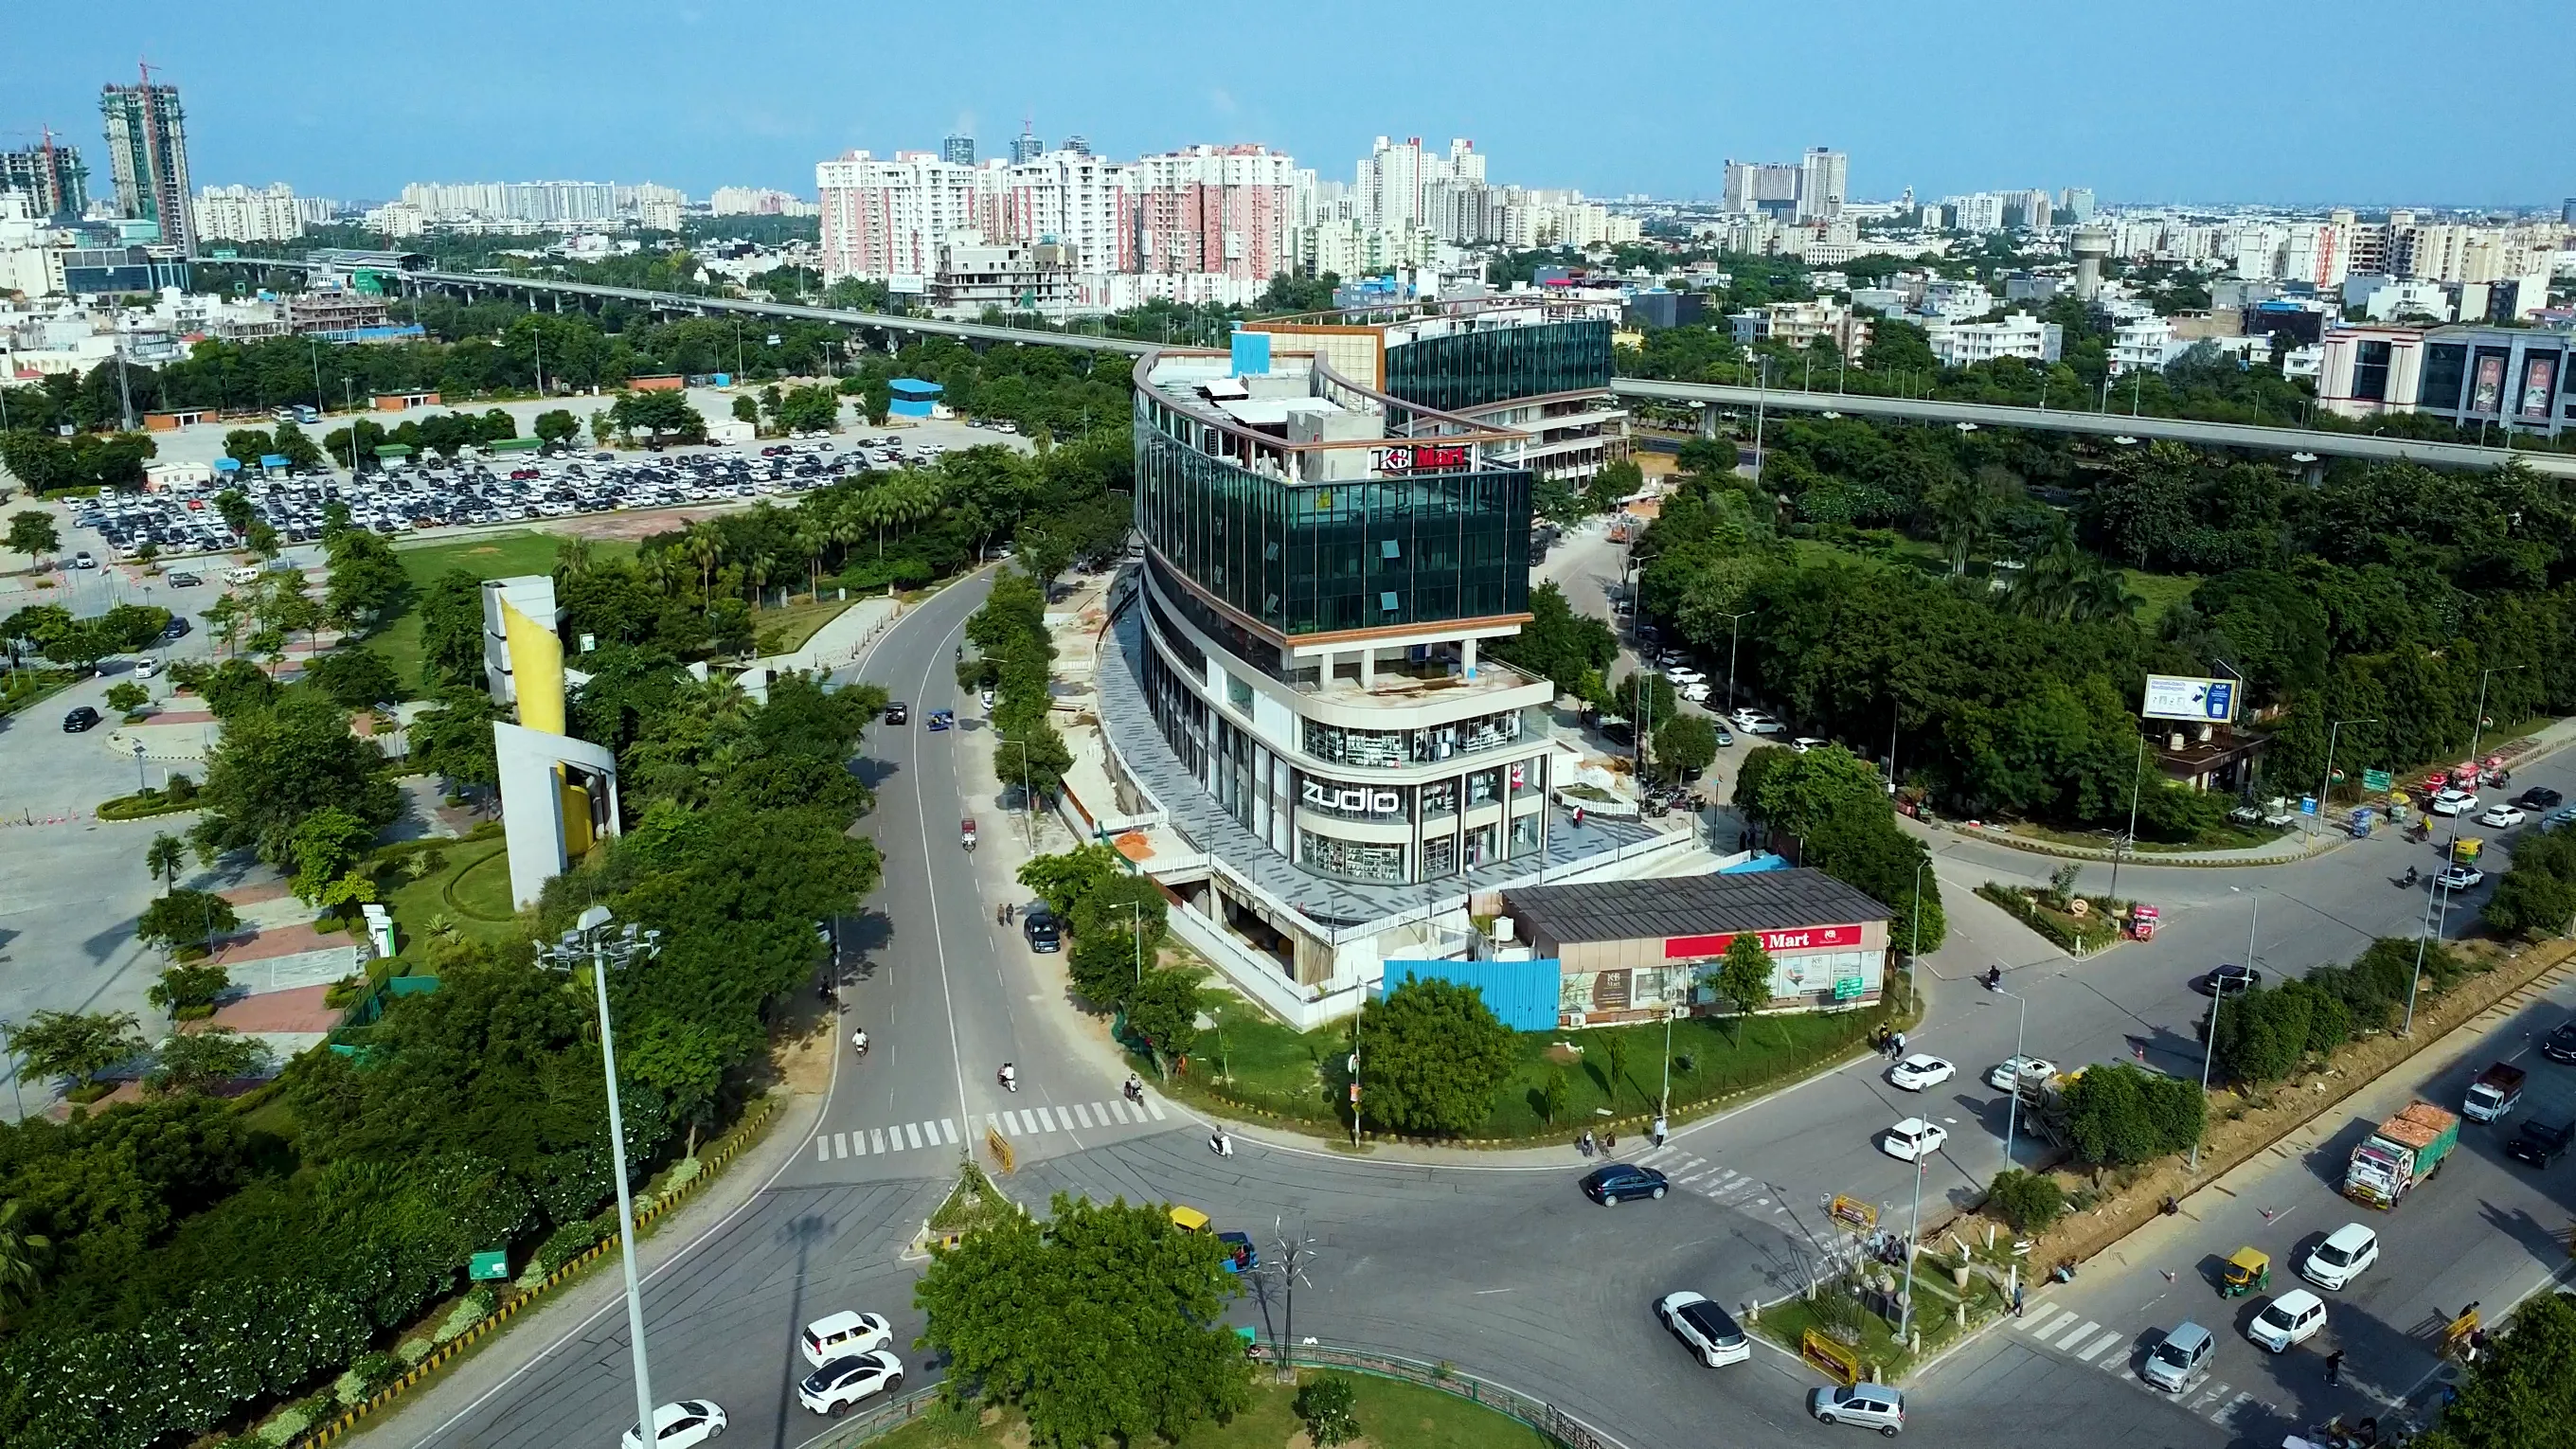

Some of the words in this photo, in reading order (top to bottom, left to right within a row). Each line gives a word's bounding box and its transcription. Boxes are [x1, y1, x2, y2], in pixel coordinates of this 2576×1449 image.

[1416, 446, 1464, 466] Mart
[1302, 779, 1399, 813] zudio
[1768, 933, 1810, 948] Mart
